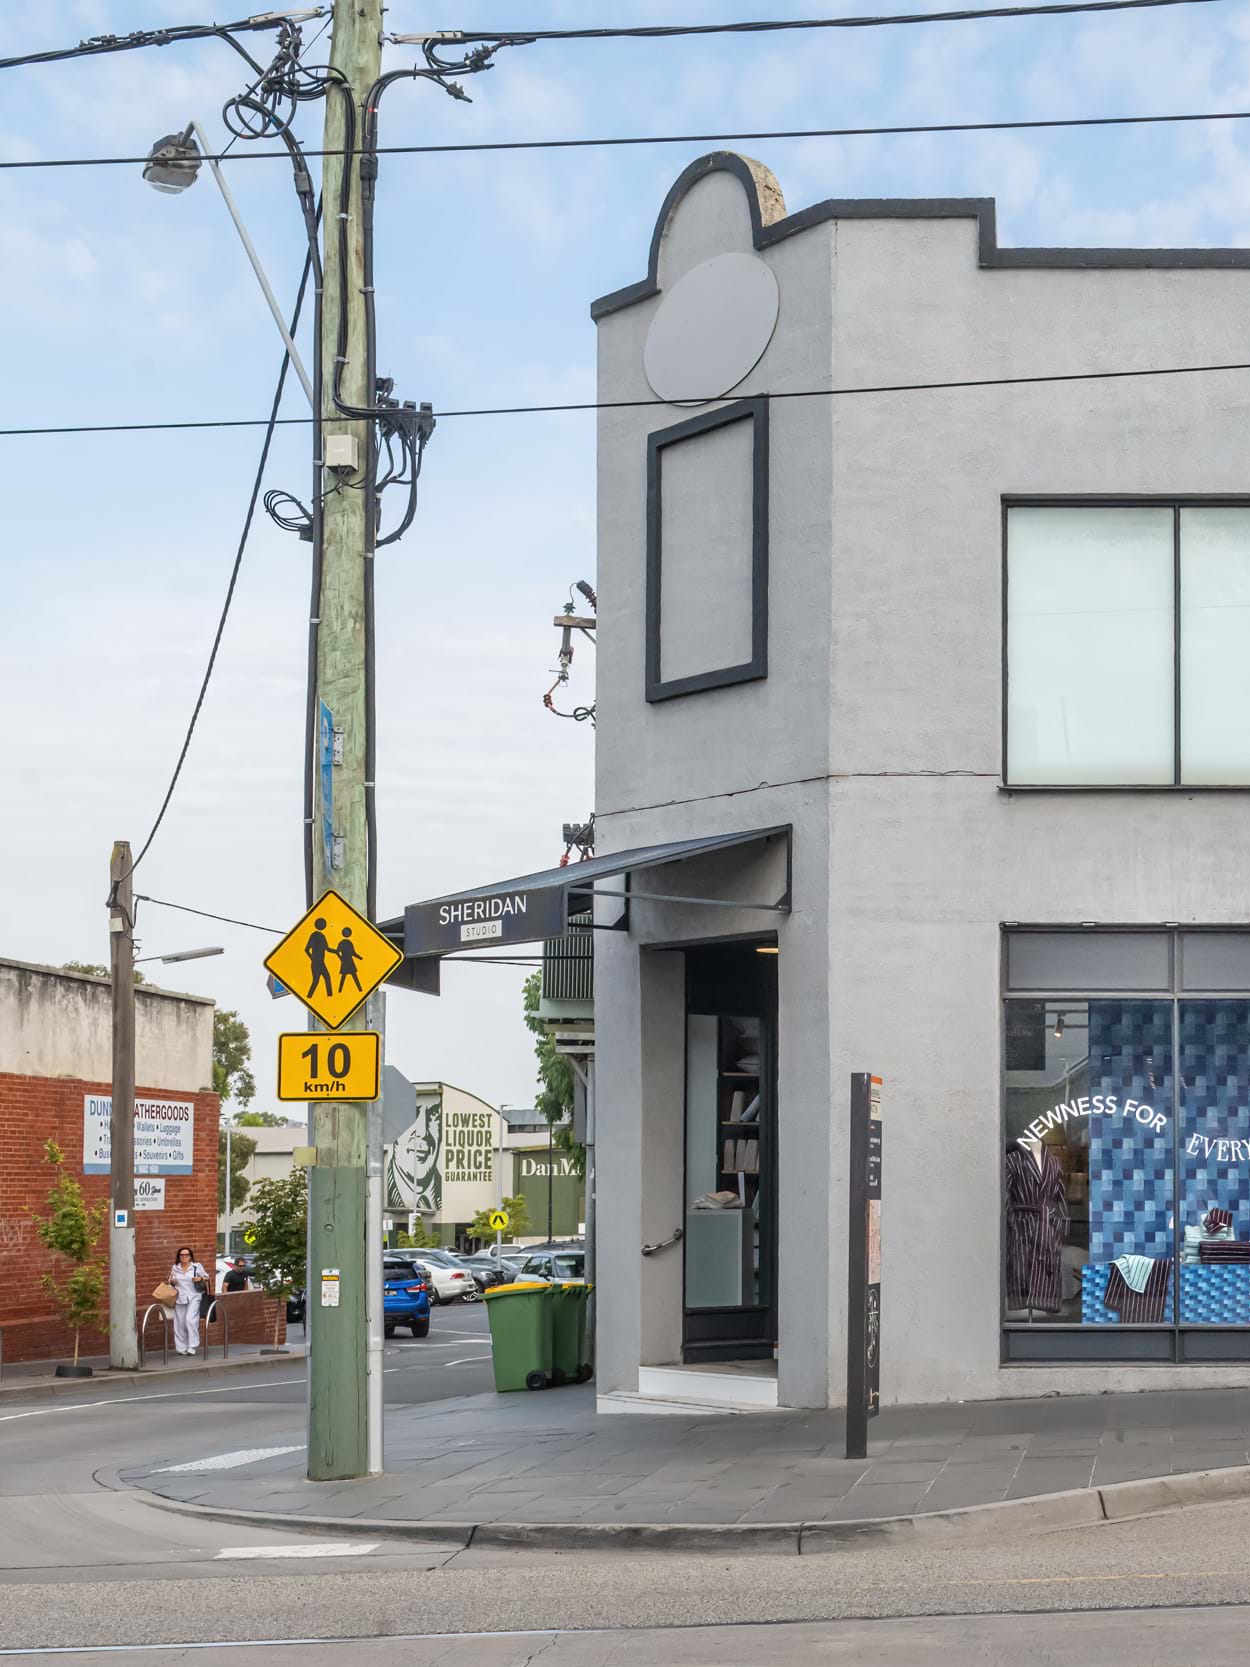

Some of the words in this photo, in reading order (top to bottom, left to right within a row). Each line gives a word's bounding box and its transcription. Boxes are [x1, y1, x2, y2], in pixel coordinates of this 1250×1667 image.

[439, 894, 527, 925] SHERIDAN
[465, 925, 498, 937] STUDIO
[301, 1043, 351, 1080] 10
[304, 1081, 346, 1093] km/h
[134, 1103, 189, 1121] ATHERGOODS
[445, 1113, 492, 1128] LOWEST
[160, 1122, 181, 1135] Luggage
[1016, 1095, 1117, 1151] NEWNESS
[1123, 1100, 1167, 1133] FOR
[445, 1130, 492, 1149] LIQUOR
[445, 1149, 492, 1170] PRICE
[521, 1159, 557, 1176] Dan
[445, 1171, 493, 1182] GUARANTEE
[139, 1181, 151, 1196] 60
